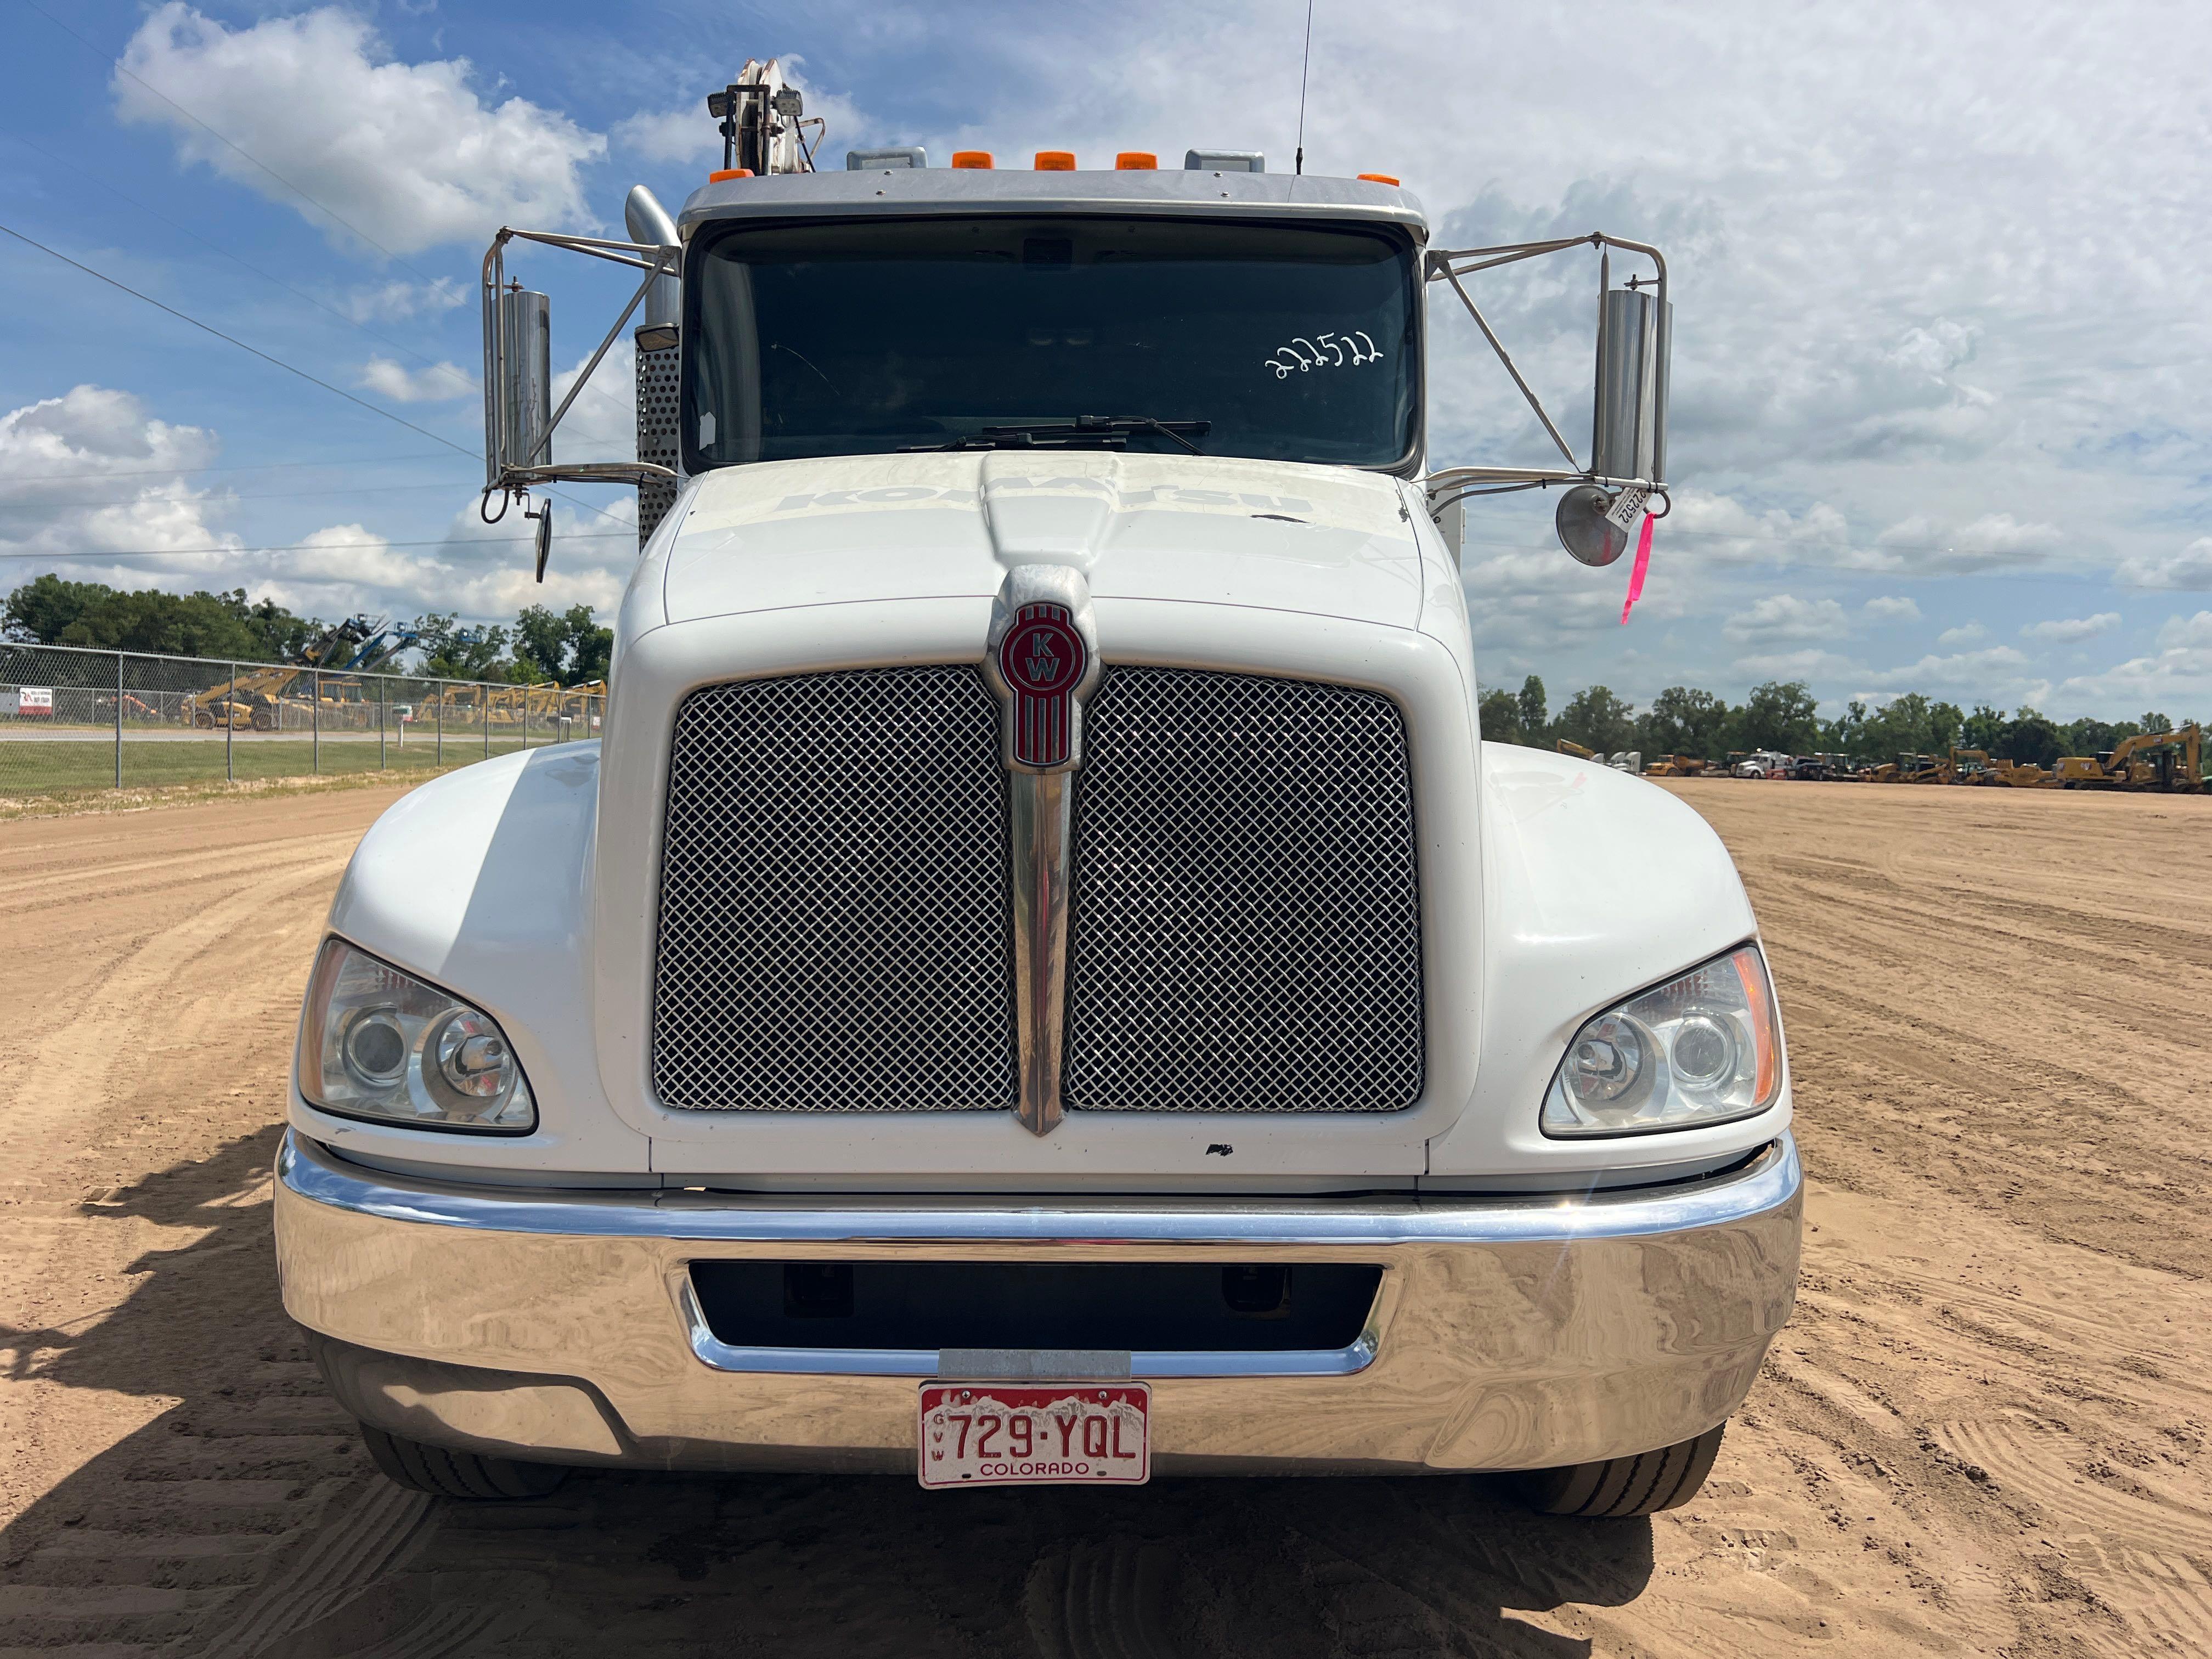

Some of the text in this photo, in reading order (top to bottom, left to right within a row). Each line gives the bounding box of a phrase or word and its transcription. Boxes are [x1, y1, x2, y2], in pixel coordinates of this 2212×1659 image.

[1264, 331, 1384, 379] 222522
[1618, 489, 1646, 523] 222522
[980, 1463, 1090, 1476] COLORADO
